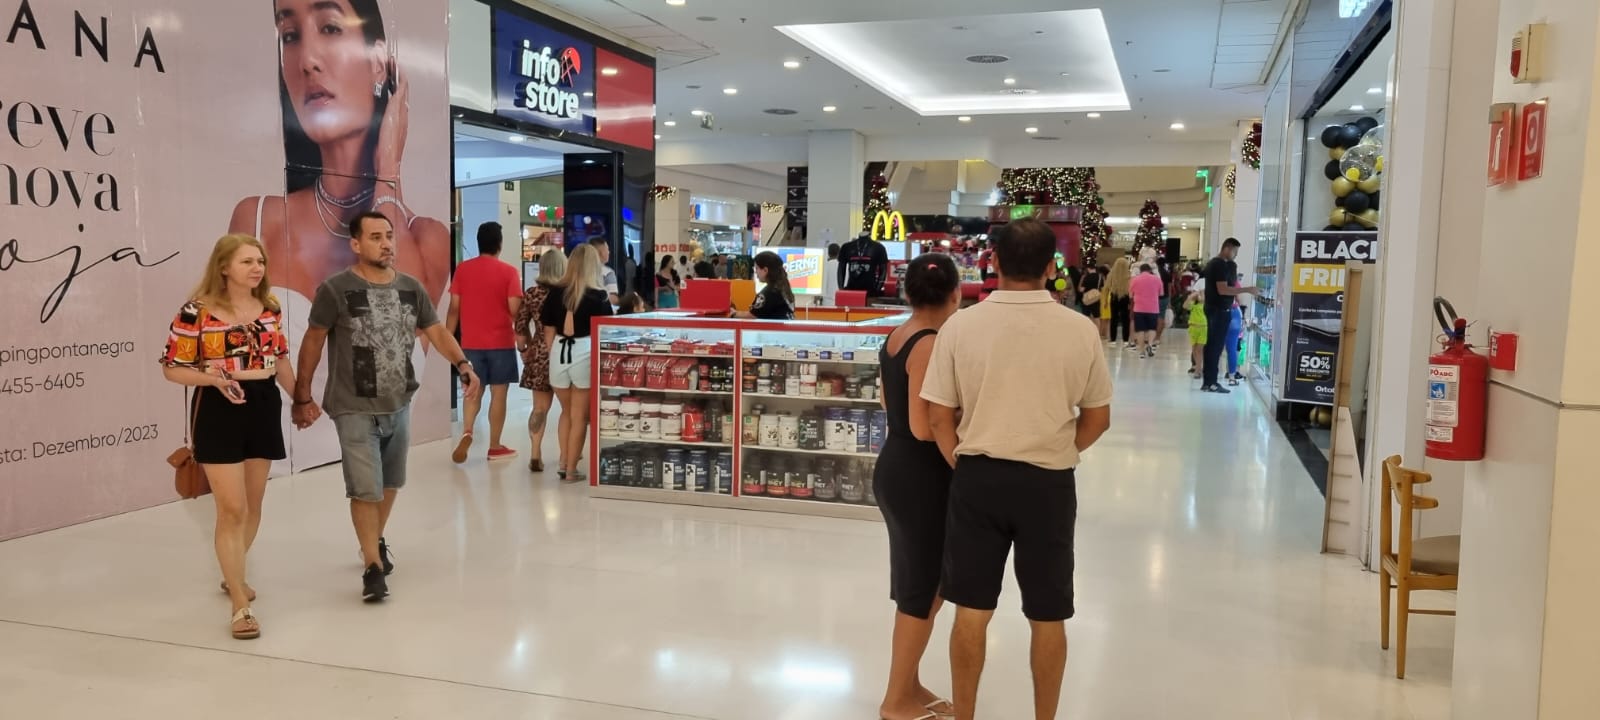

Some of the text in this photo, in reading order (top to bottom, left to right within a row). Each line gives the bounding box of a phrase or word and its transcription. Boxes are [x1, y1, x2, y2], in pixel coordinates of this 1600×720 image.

[522, 39, 560, 86] info
[526, 81, 579, 118] store
[0, 101, 115, 157] eve
[0, 341, 135, 366] pingpontanegra
[1300, 355, 1331, 369] 50%
[0, 372, 85, 394] 455-6405
[33, 424, 159, 458] Dezembro/2023
